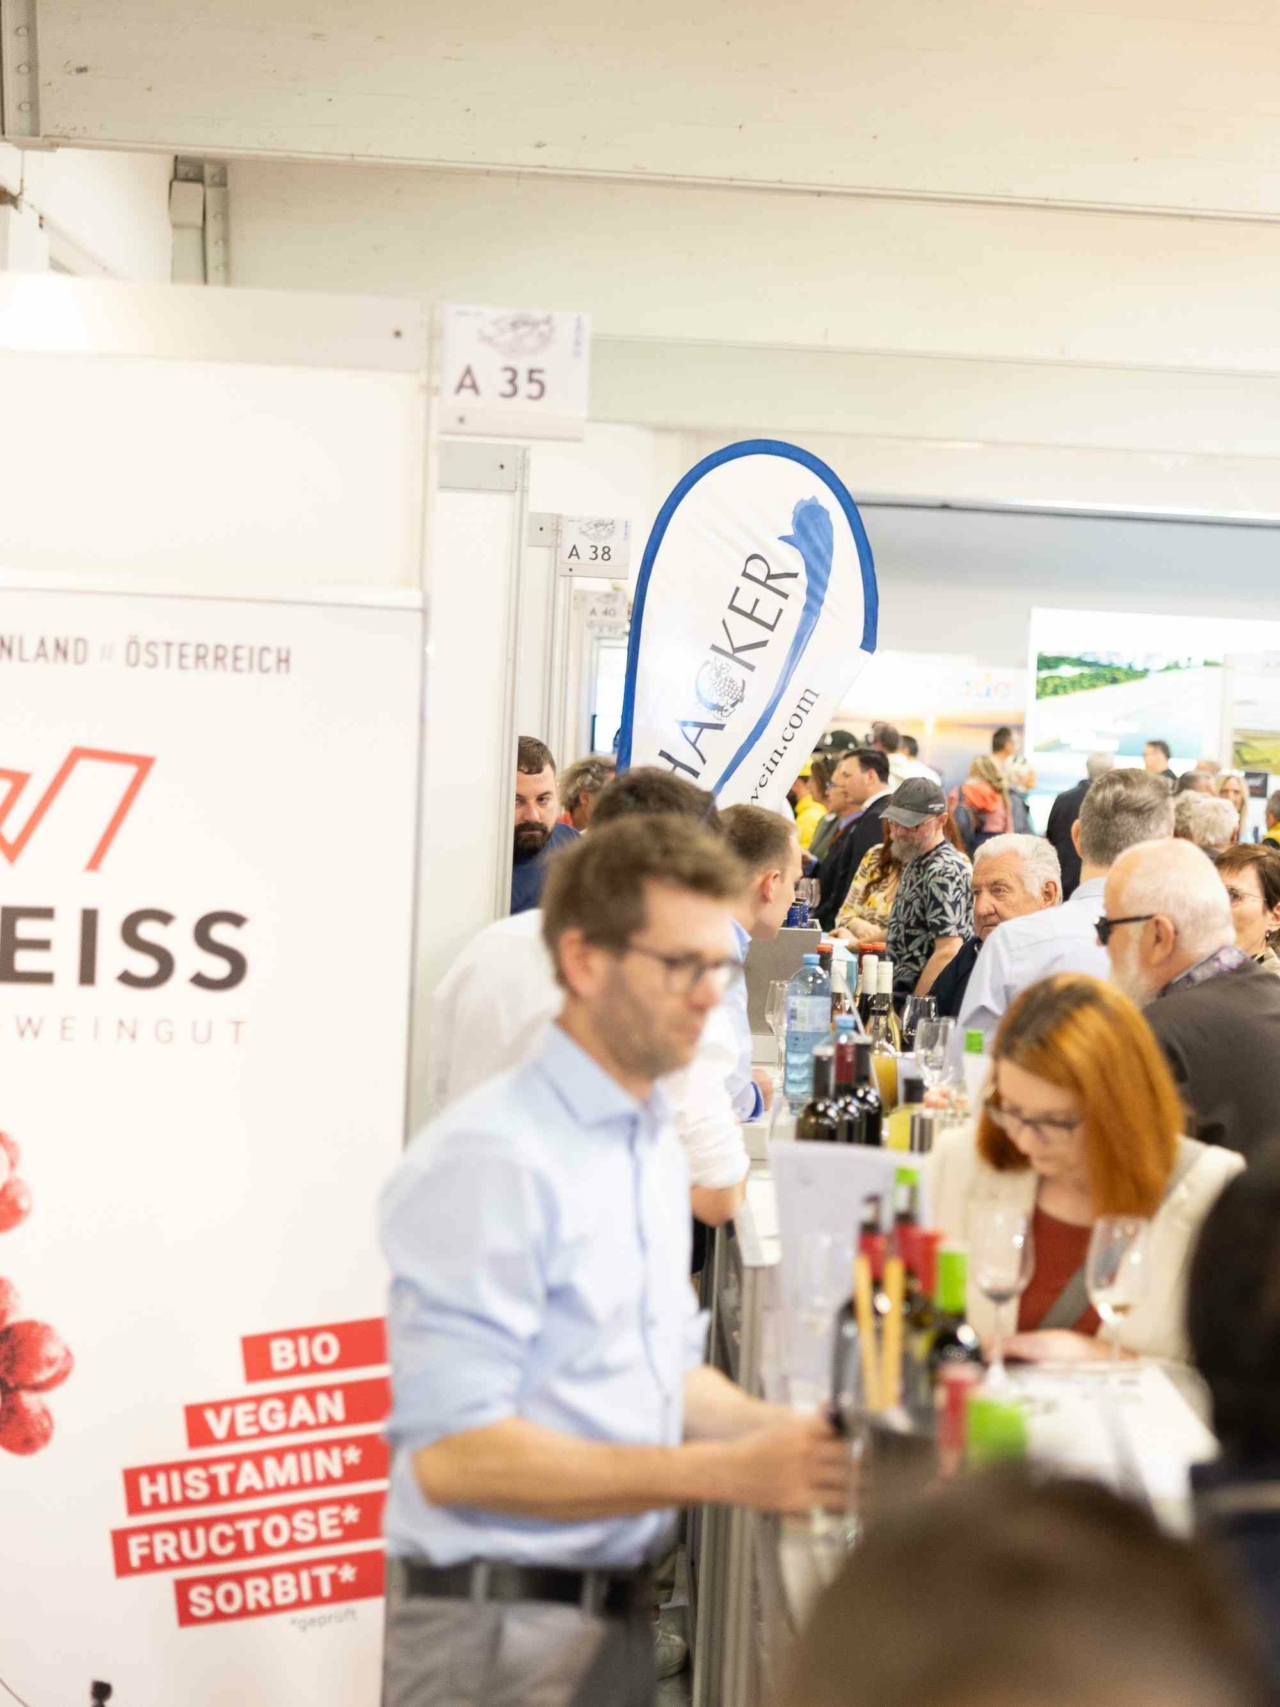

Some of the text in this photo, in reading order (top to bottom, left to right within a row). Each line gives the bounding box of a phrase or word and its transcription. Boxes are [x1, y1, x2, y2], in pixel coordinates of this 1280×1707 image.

[455, 364, 546, 401] A 35
[567, 543, 612, 562] A 38
[124, 635, 293, 674] ÖSTERREICH
[0, 905, 250, 993] EISS
[14, 1014, 249, 1046] WEINGUT
[268, 1331, 341, 1373] BIO
[203, 1389, 346, 1440] VEGAN
